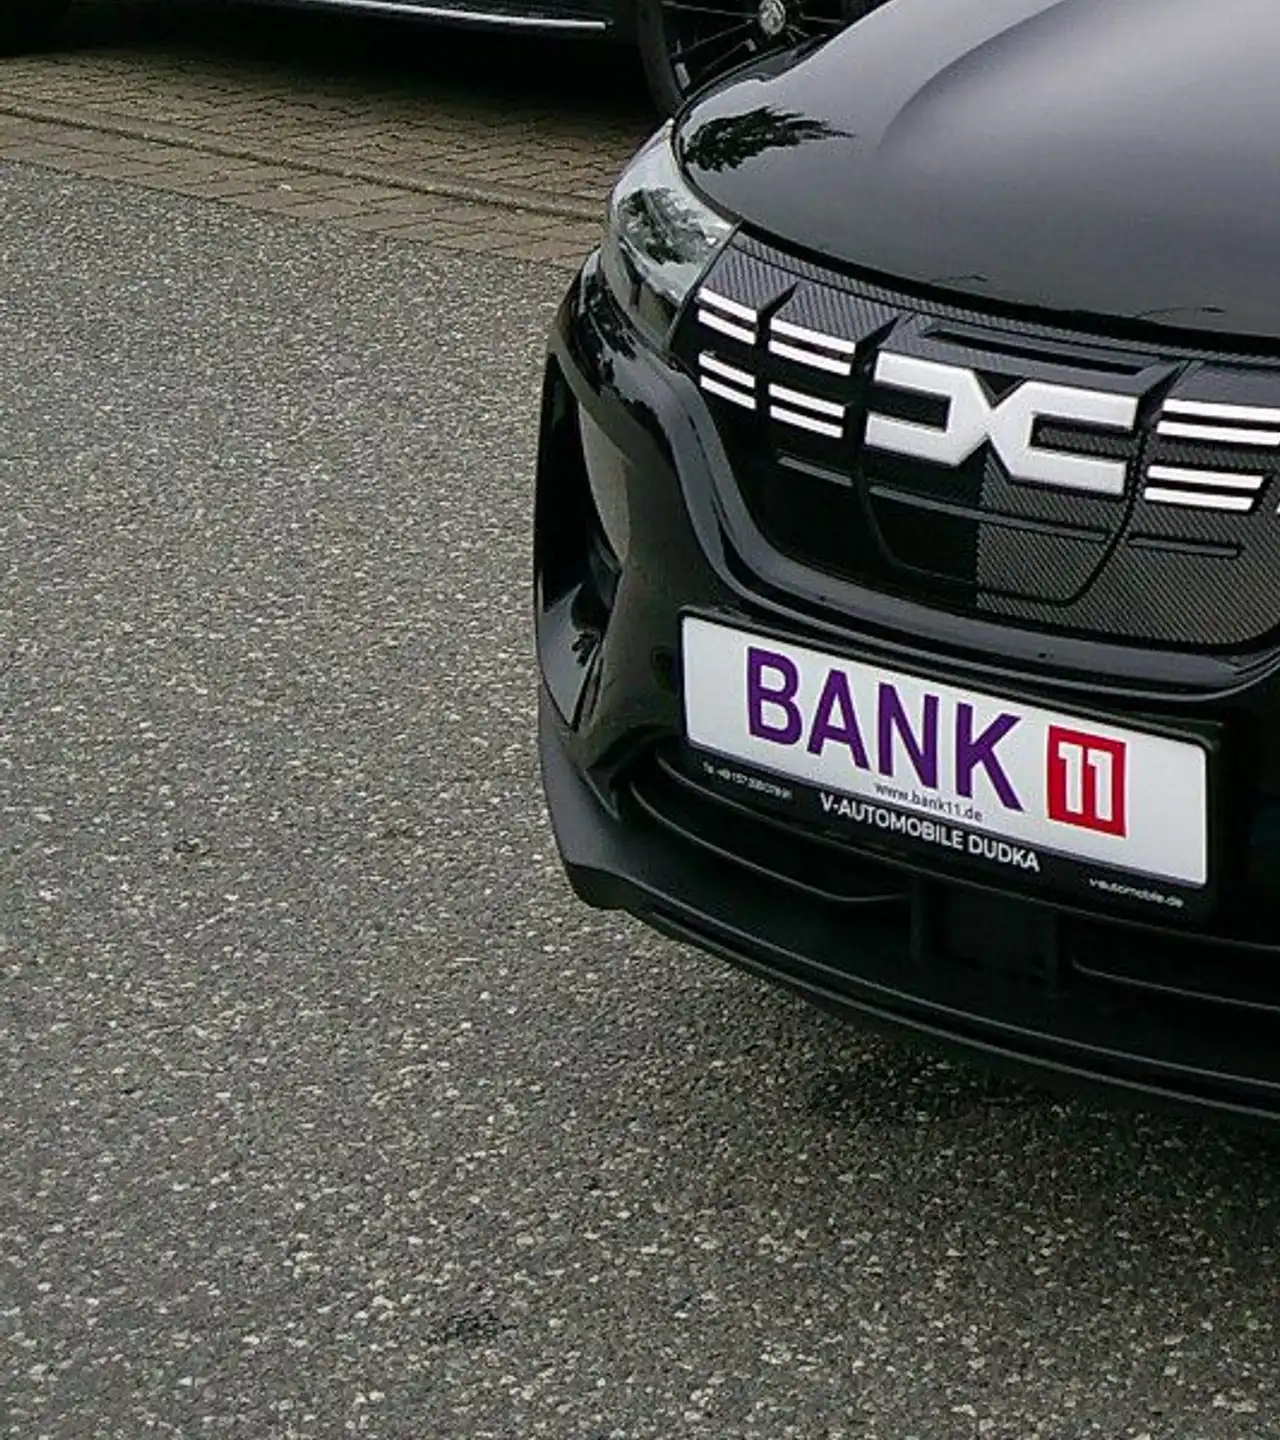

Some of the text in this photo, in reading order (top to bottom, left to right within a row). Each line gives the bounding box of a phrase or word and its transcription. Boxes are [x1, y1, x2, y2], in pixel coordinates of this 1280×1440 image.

[747, 645, 1114, 823] BANK 11
[819, 791, 1041, 873] V-AUTOMOBILE DUDKA
[873, 781, 984, 823] www.bank11.de
